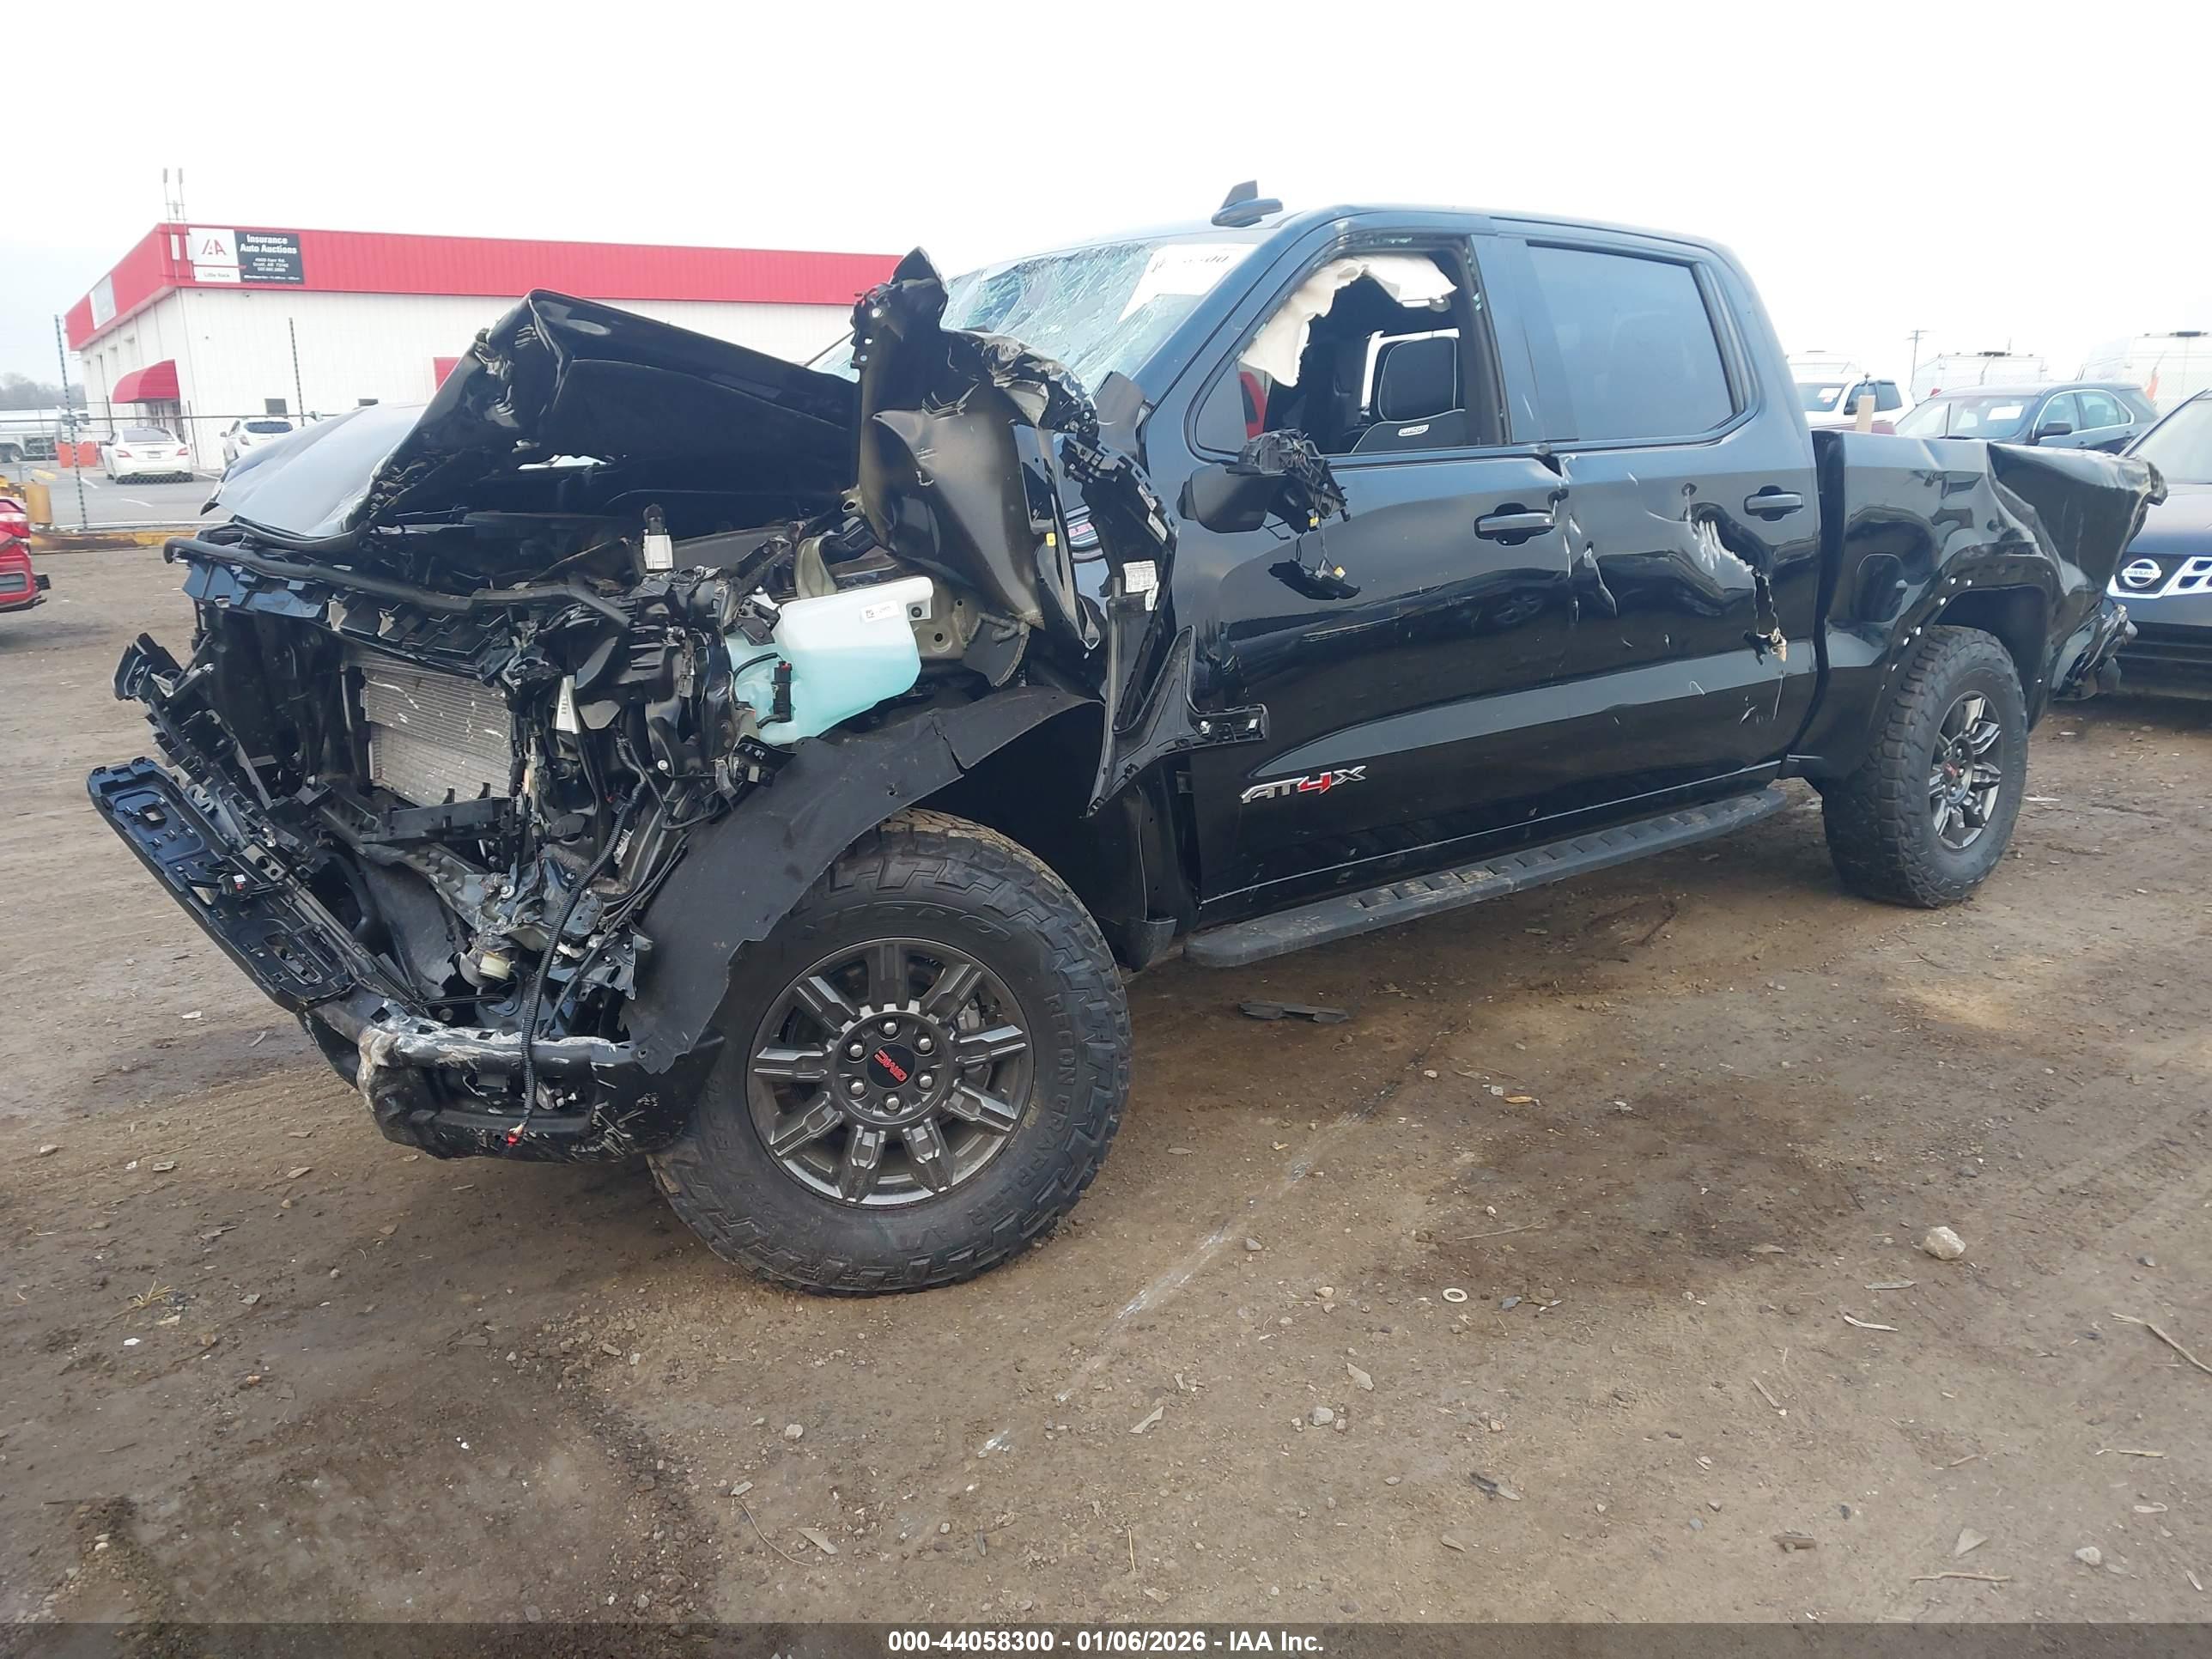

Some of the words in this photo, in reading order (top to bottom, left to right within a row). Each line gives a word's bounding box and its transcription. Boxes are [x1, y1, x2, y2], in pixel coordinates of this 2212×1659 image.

[240, 243, 259, 252] Auto
[261, 245, 297, 254] Auctions
[246, 234, 289, 245] Insurance
[1240, 765, 1367, 804] AT4X
[1044, 994, 1076, 1085] RECON
[874, 1049, 908, 1082] GMC
[968, 1093, 1072, 1226] GRAPPLER
